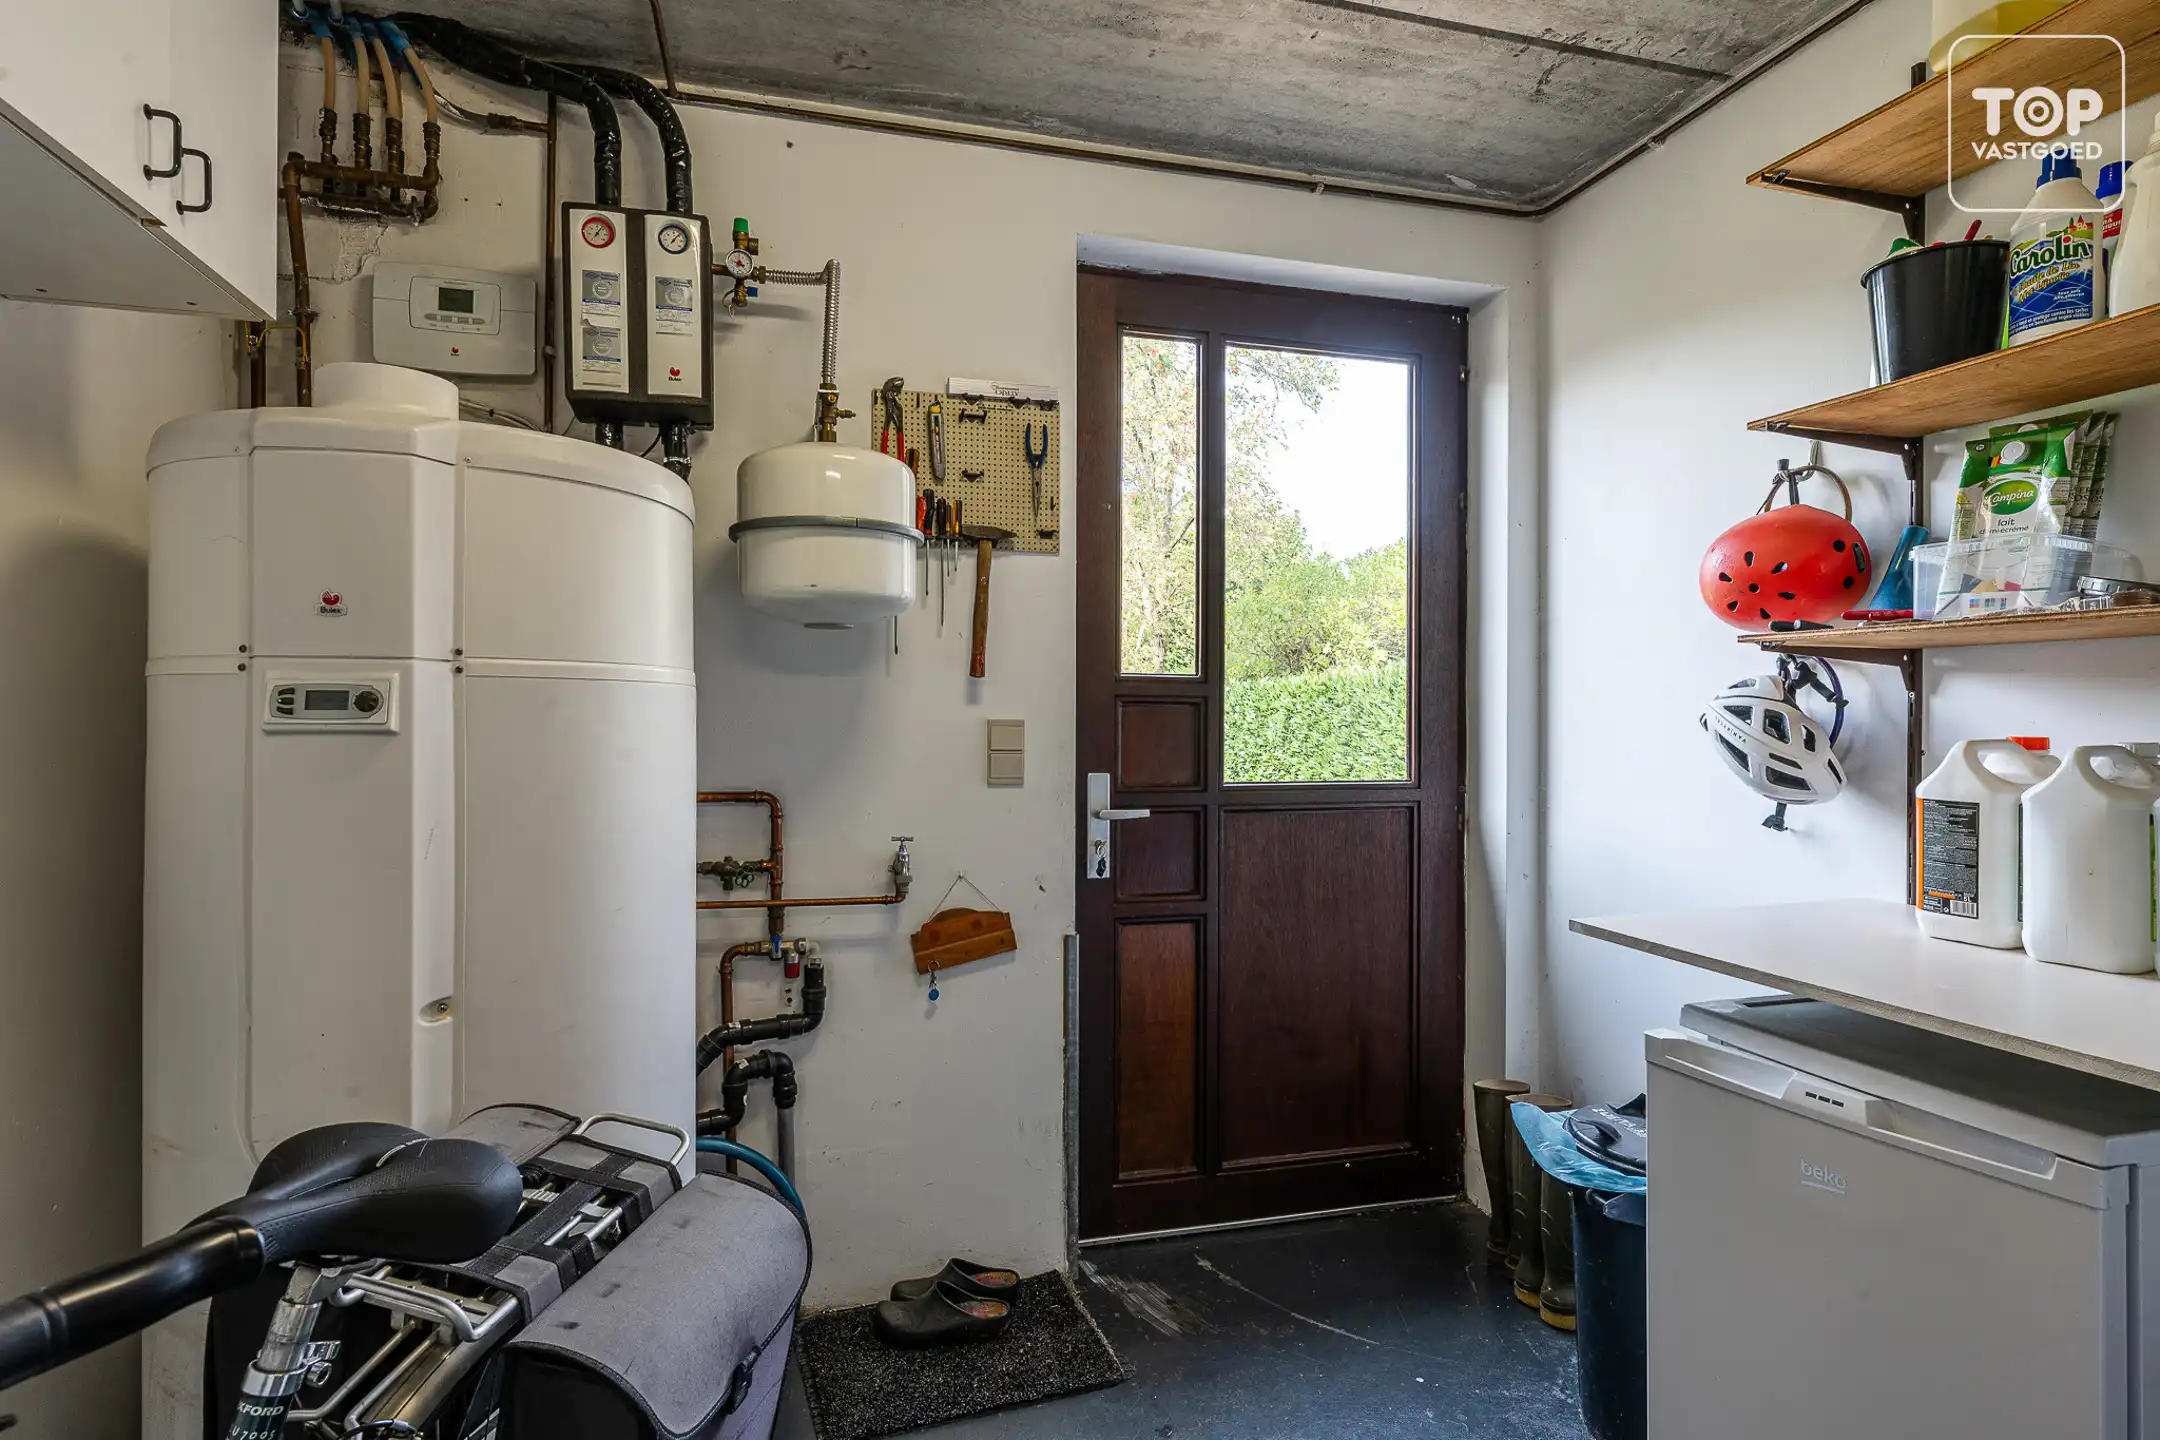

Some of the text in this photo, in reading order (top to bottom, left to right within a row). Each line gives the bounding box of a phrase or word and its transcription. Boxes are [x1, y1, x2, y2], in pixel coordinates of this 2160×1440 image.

[2010, 233, 2090, 277] Carolin
[1988, 490, 2034, 506] Campina
[1997, 517, 2016, 527] lait
[320, 605, 342, 614] Bulex
[1800, 1157, 1847, 1188] beko
